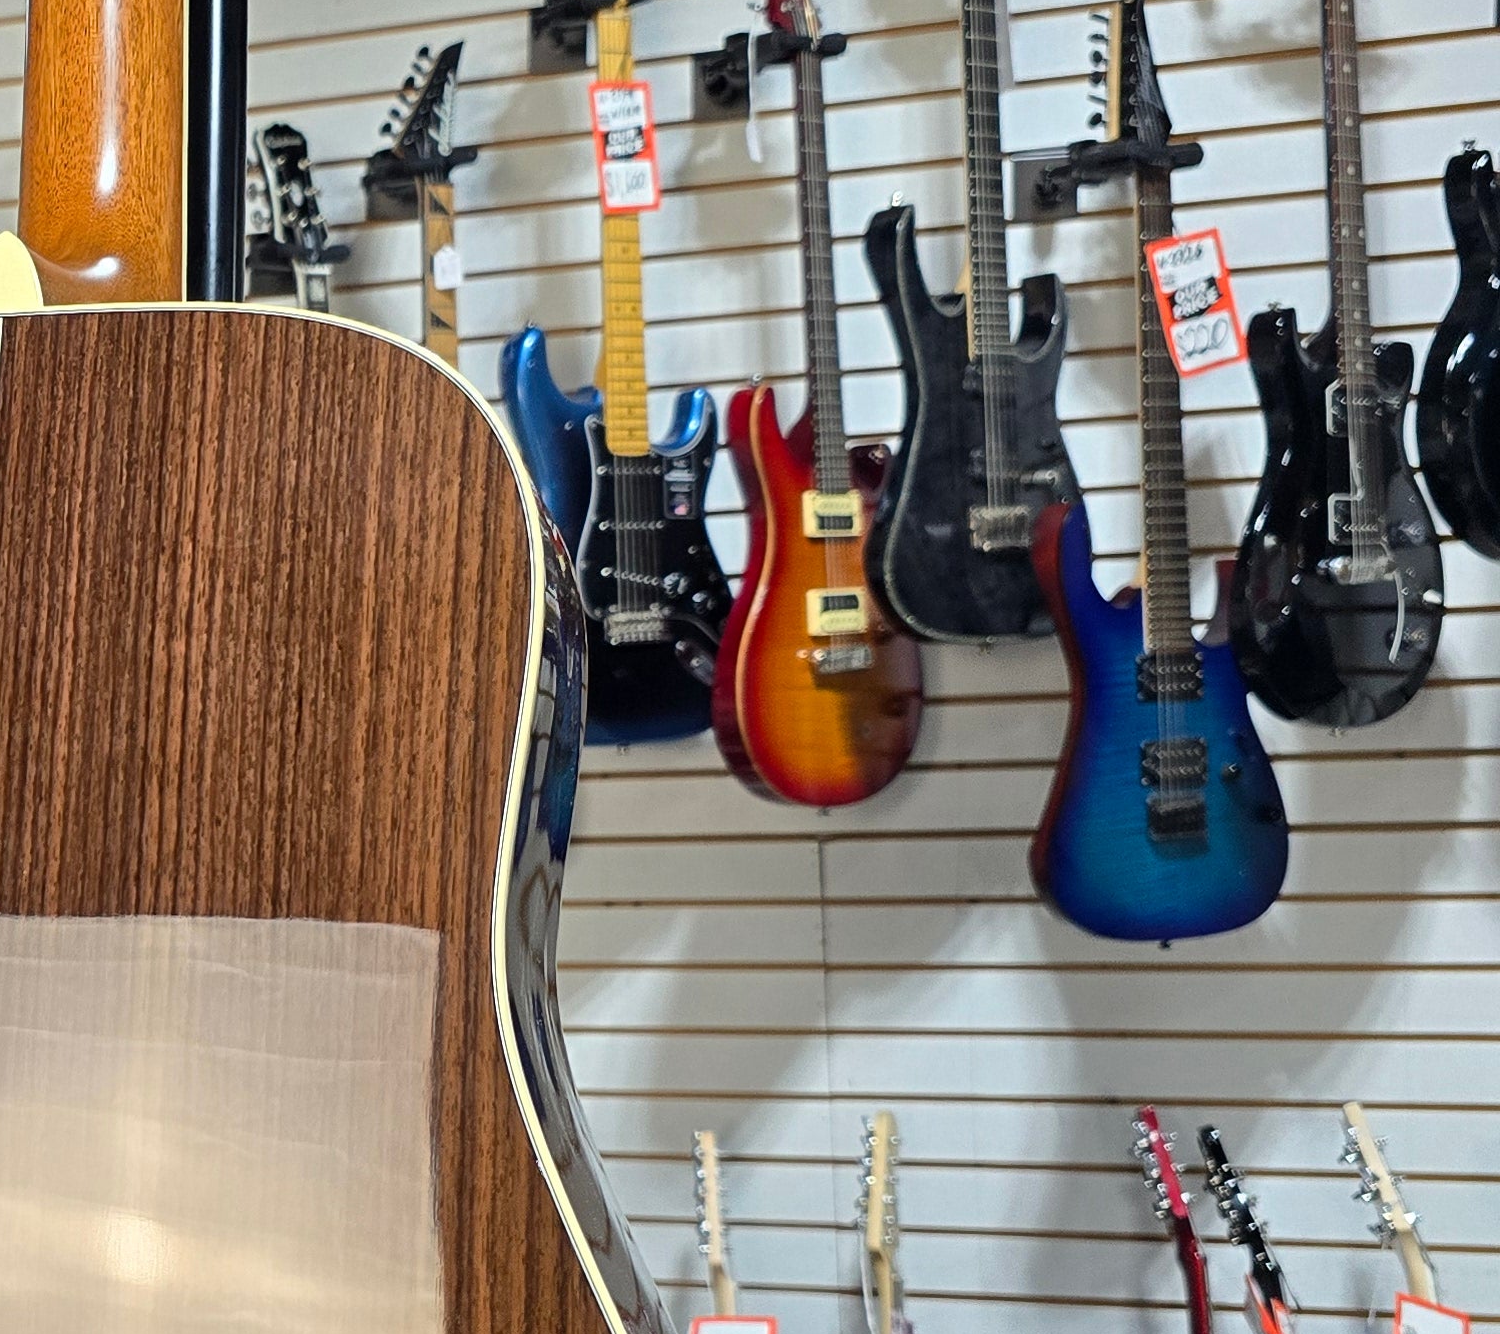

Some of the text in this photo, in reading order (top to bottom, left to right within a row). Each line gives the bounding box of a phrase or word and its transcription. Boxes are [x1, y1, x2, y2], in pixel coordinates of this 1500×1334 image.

[605, 137, 645, 160] PRICE
[607, 127, 640, 146] OUR
[1173, 274, 1209, 305] OUR
[1171, 286, 1220, 321] PRICE
